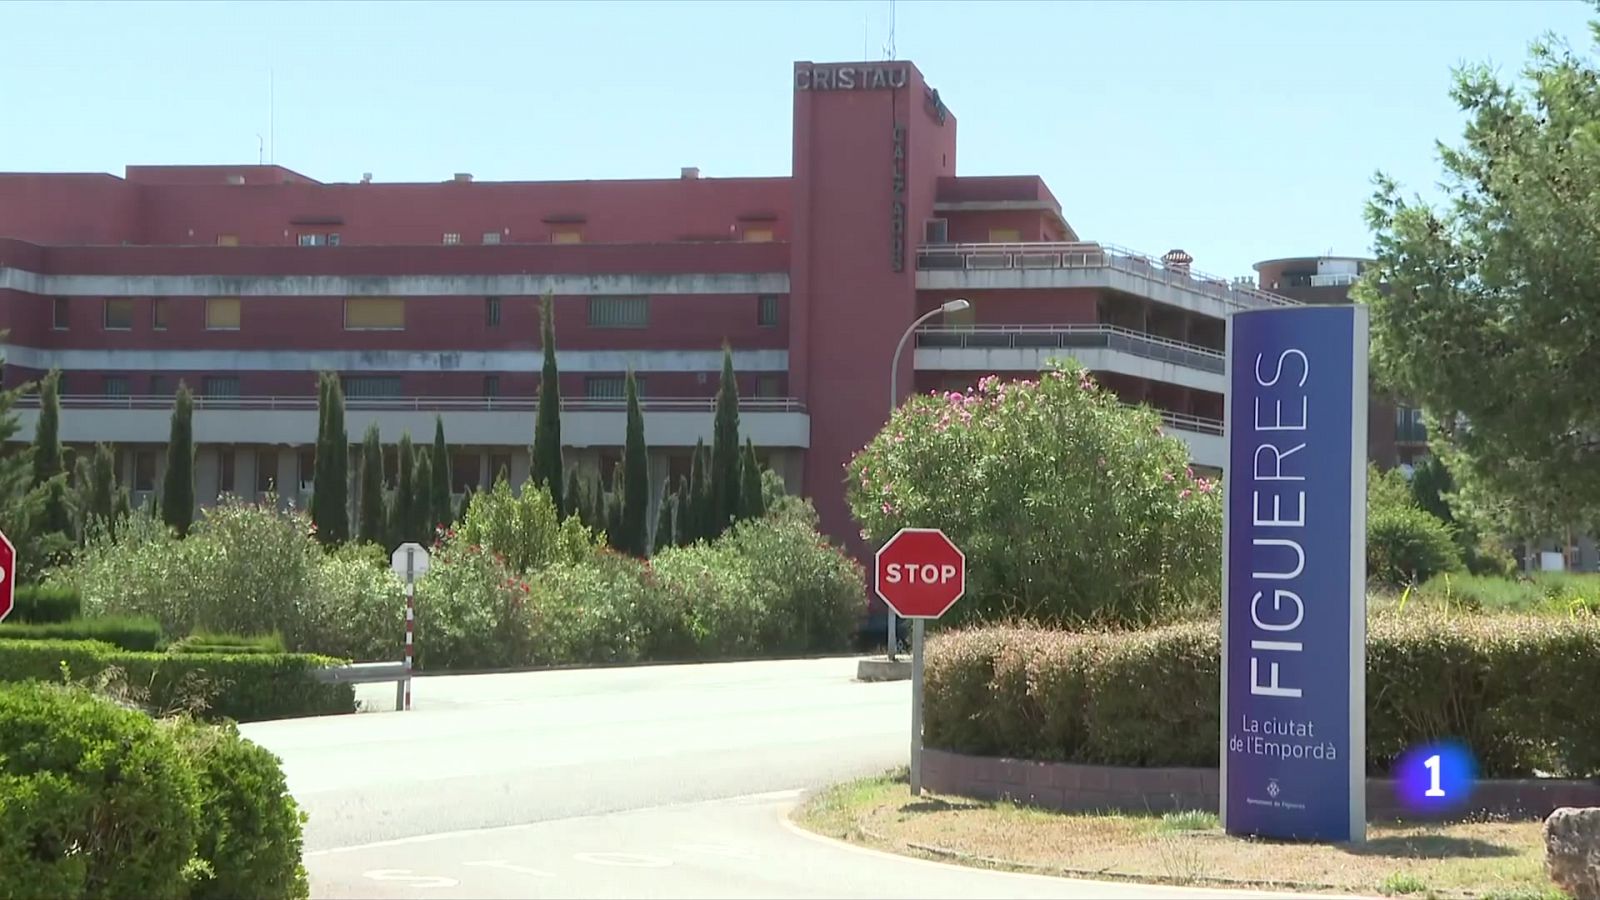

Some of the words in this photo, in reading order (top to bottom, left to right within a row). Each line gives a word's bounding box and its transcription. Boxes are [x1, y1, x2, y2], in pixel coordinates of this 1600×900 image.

[795, 66, 907, 91] CRISTAU
[1250, 348, 1309, 697] FIGUERES
[885, 563, 957, 584] STOP
[1243, 713, 1259, 733] La
[1263, 716, 1314, 737] ciutat
[1229, 734, 1244, 752] de
[1247, 735, 1336, 760] l'Empordà
